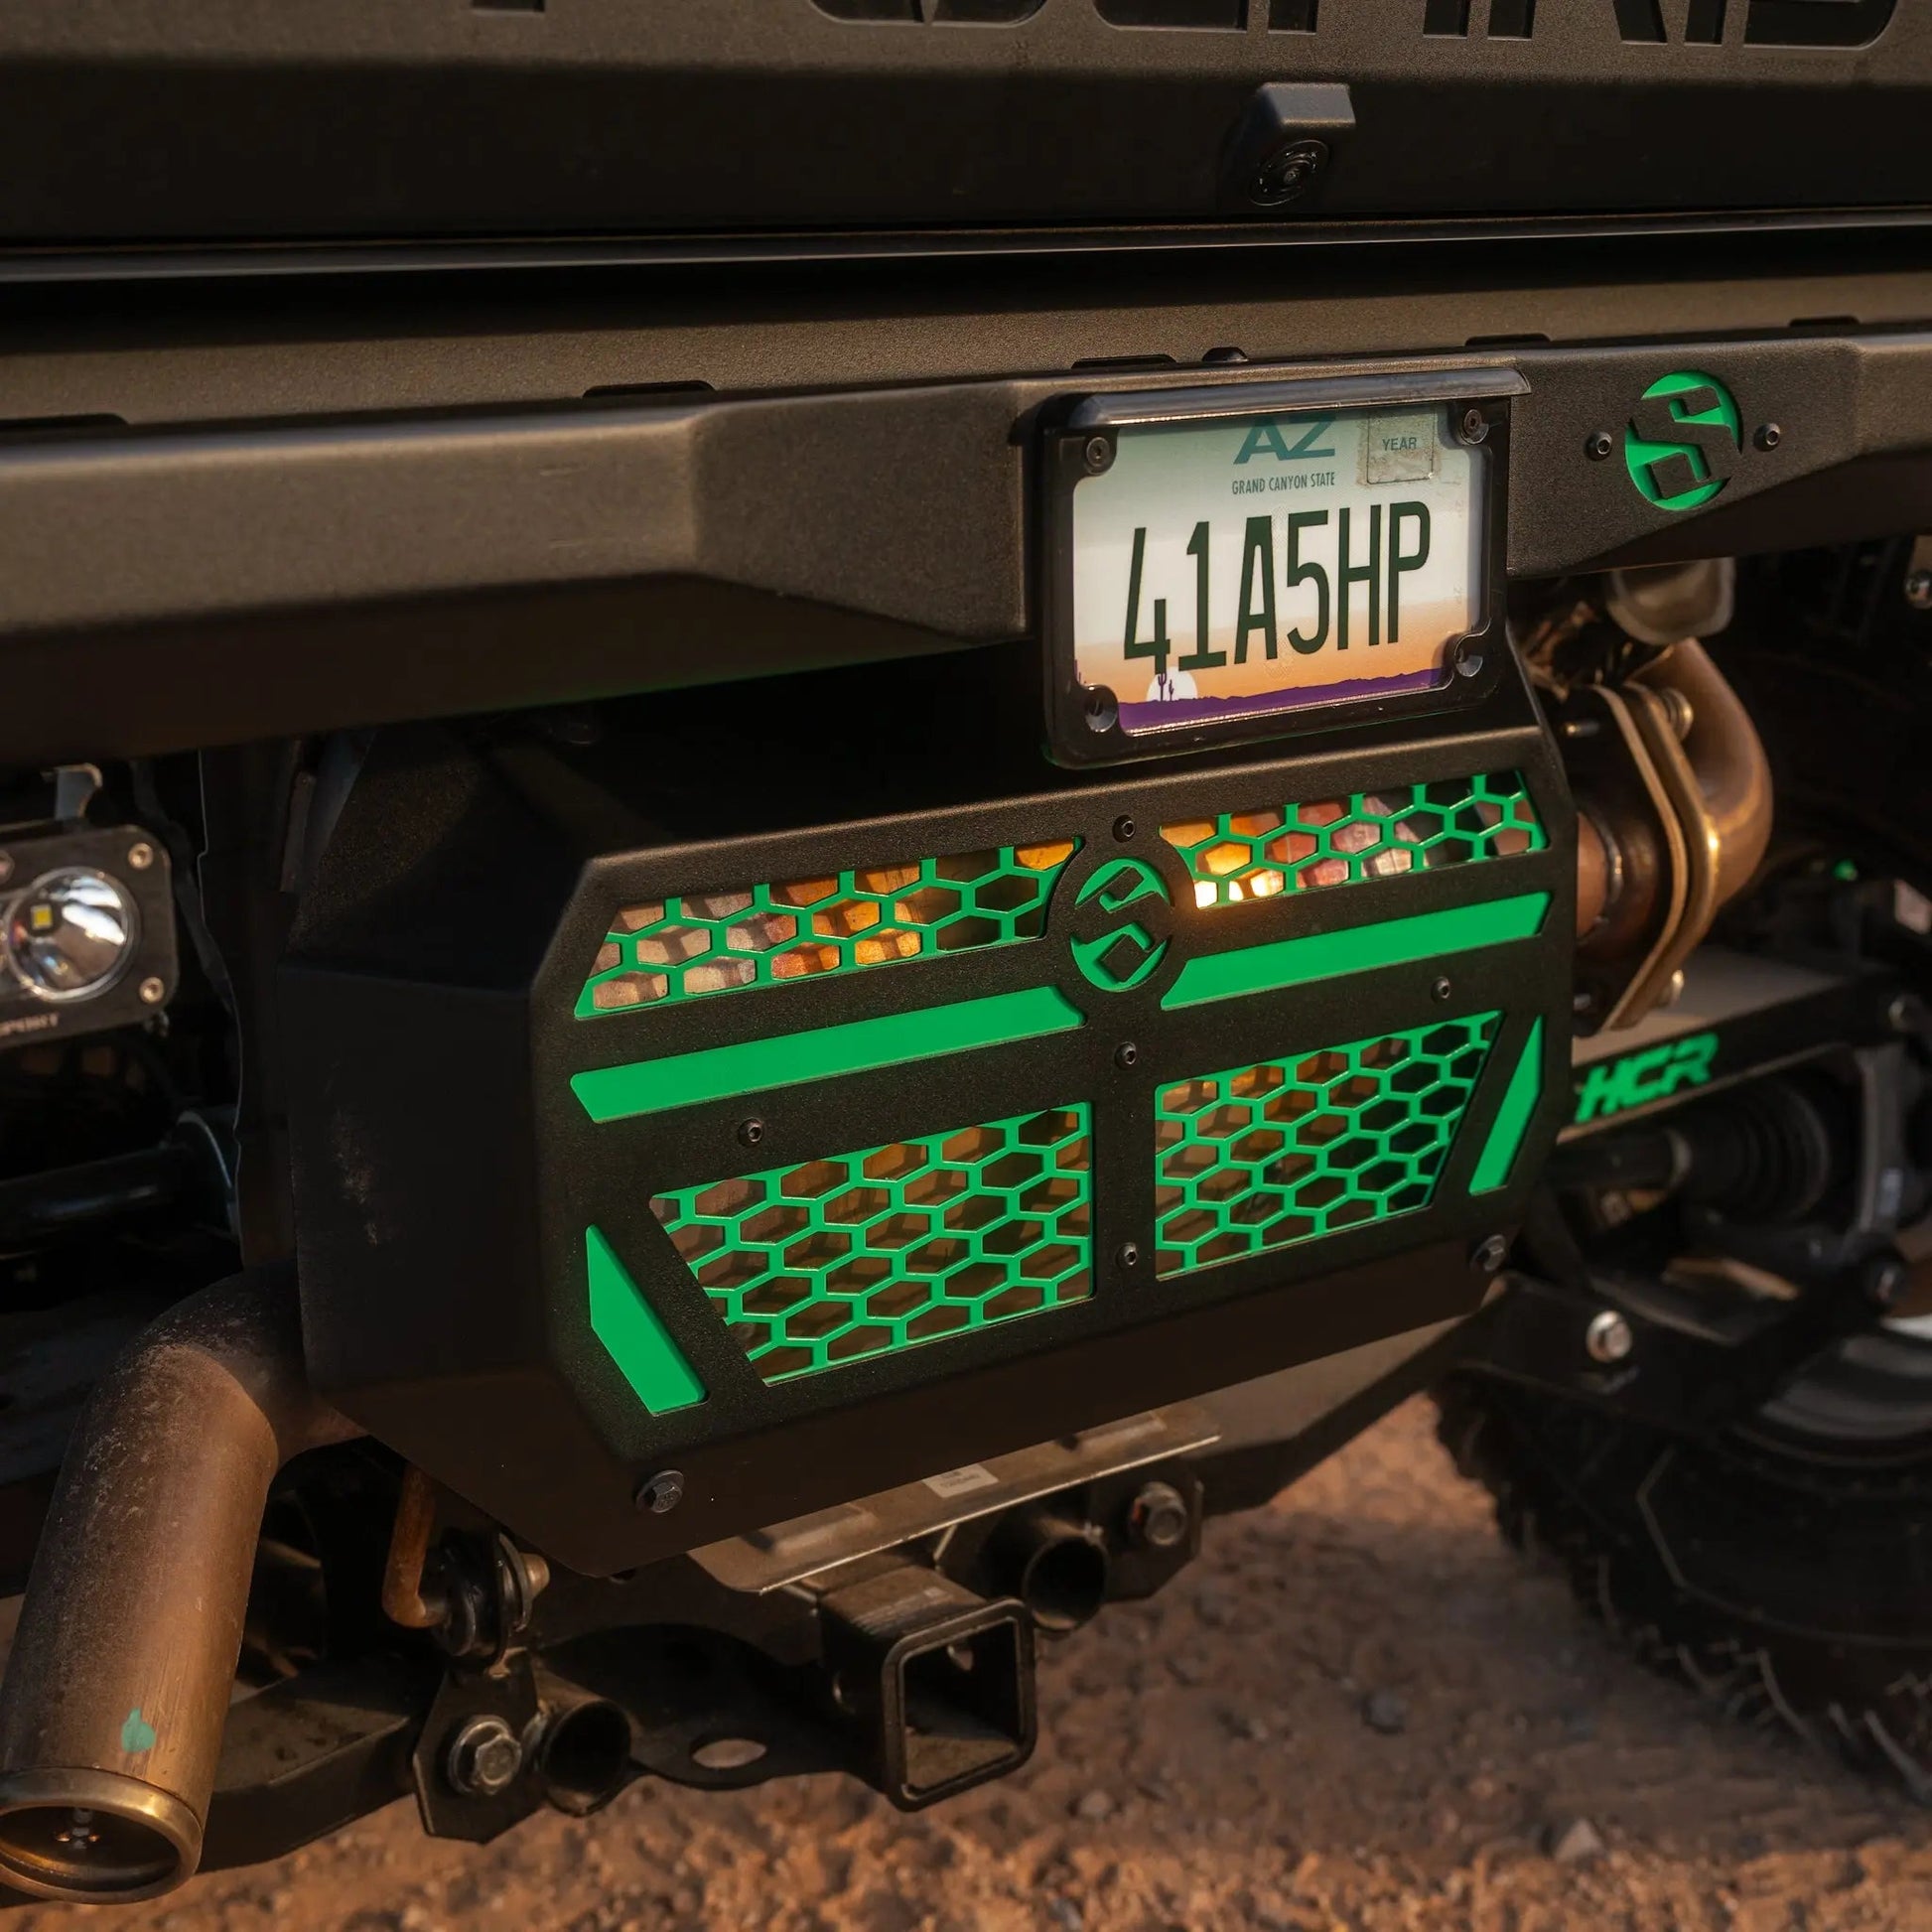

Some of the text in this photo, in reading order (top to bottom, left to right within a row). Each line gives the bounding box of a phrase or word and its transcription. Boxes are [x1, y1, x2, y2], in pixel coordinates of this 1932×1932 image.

[1233, 413, 1336, 465] AZ
[1382, 437, 1417, 452] YEAR
[1232, 471, 1335, 495] GRAND CANYON STATE
[1123, 499, 1432, 675] 41A5HP
[1575, 1033, 1719, 1124] HCR
